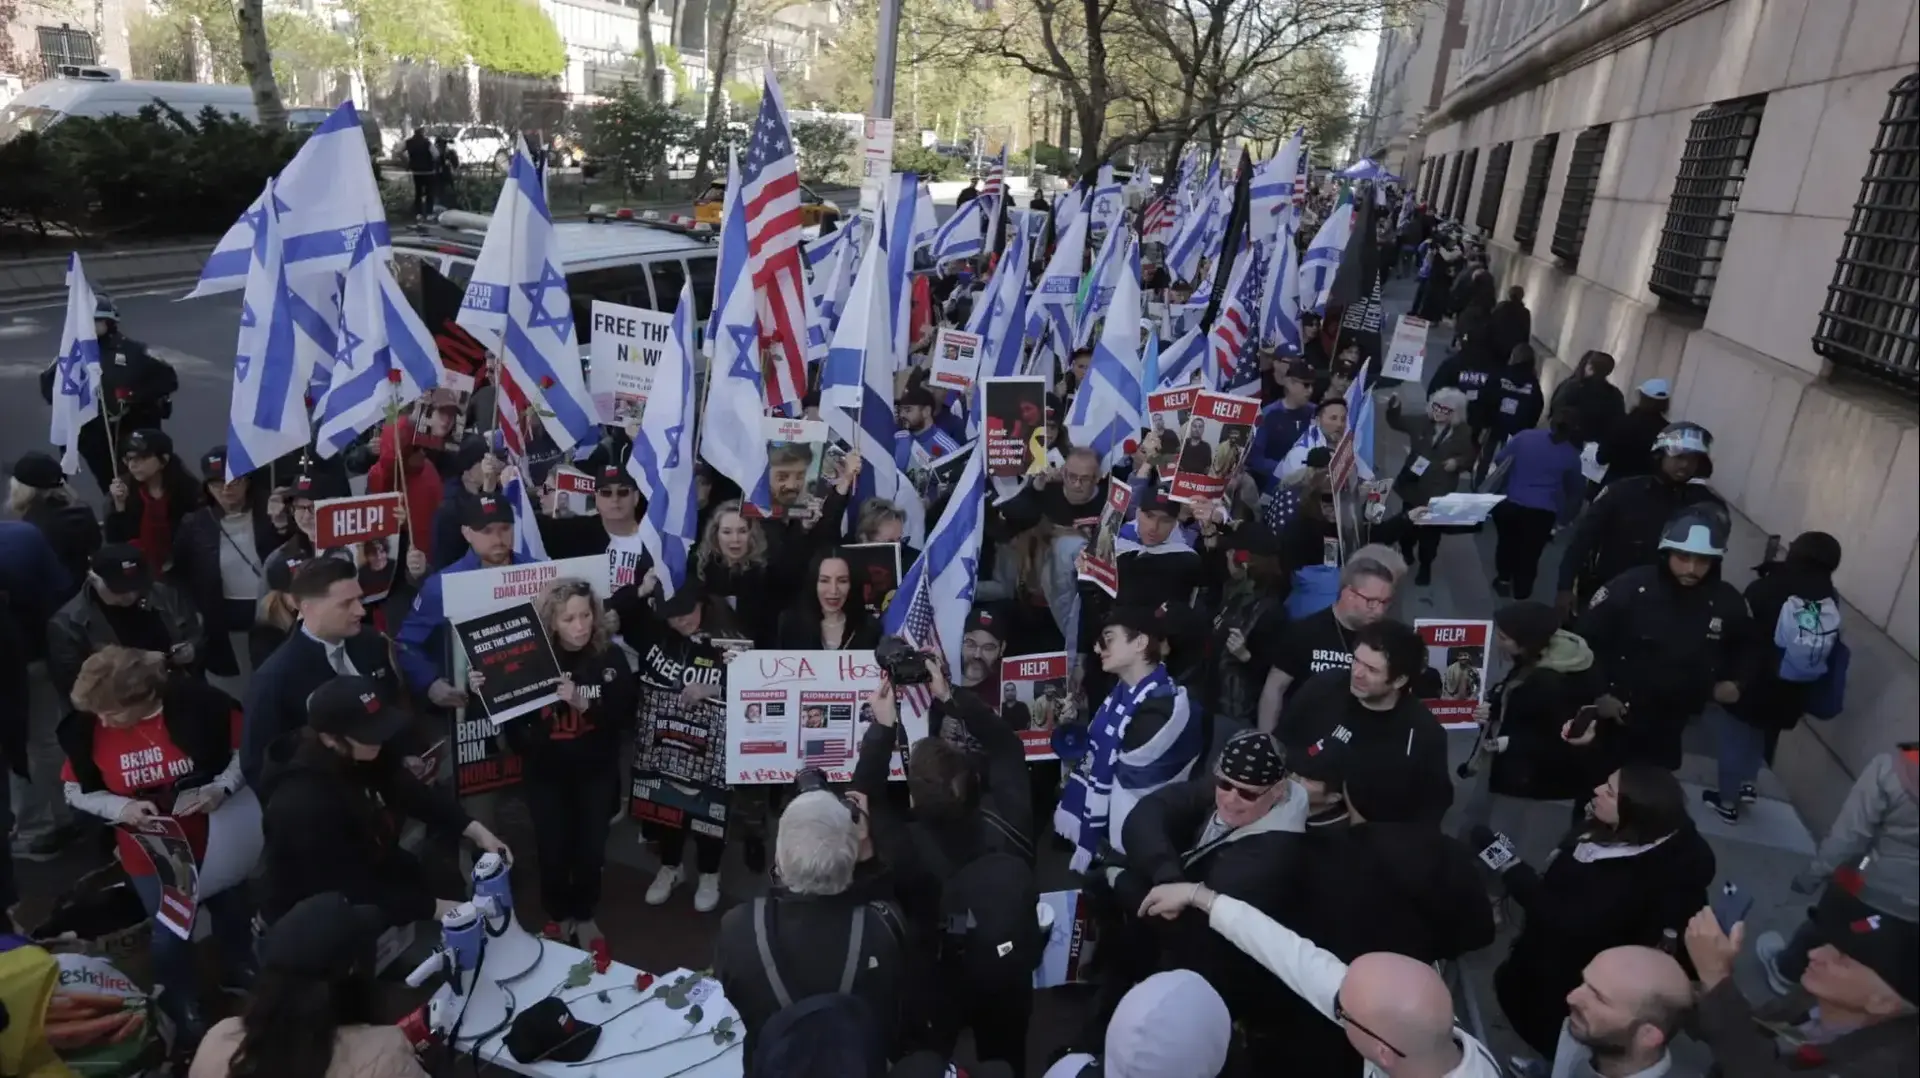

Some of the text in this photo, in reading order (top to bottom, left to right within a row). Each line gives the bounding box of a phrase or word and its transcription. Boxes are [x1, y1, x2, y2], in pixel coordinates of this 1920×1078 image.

[595, 313, 636, 338] FREE
[1393, 352, 1414, 365] 203
[1163, 391, 1190, 407] HELP!
[1212, 401, 1243, 419] HELP!
[989, 428, 1008, 436] Amit
[988, 457, 1007, 465] With
[333, 505, 385, 538] HELP!
[494, 585, 517, 600] EDAN
[1434, 627, 1467, 643] HELP!
[473, 642, 494, 655] SEIZE
[493, 637, 507, 649] THE
[645, 643, 684, 681] FREE
[1312, 649, 1354, 664] BRING
[760, 656, 816, 681] USA
[1020, 661, 1050, 677] HELP!
[742, 691, 786, 699] KIDNAPPED
[803, 692, 853, 700] KIDNAPPED
[656, 719, 669, 729] WE
[120, 746, 164, 770] BRING
[458, 739, 486, 764] HIM
[122, 764, 165, 788] THEM
[1070, 919, 1085, 959] HELP!
